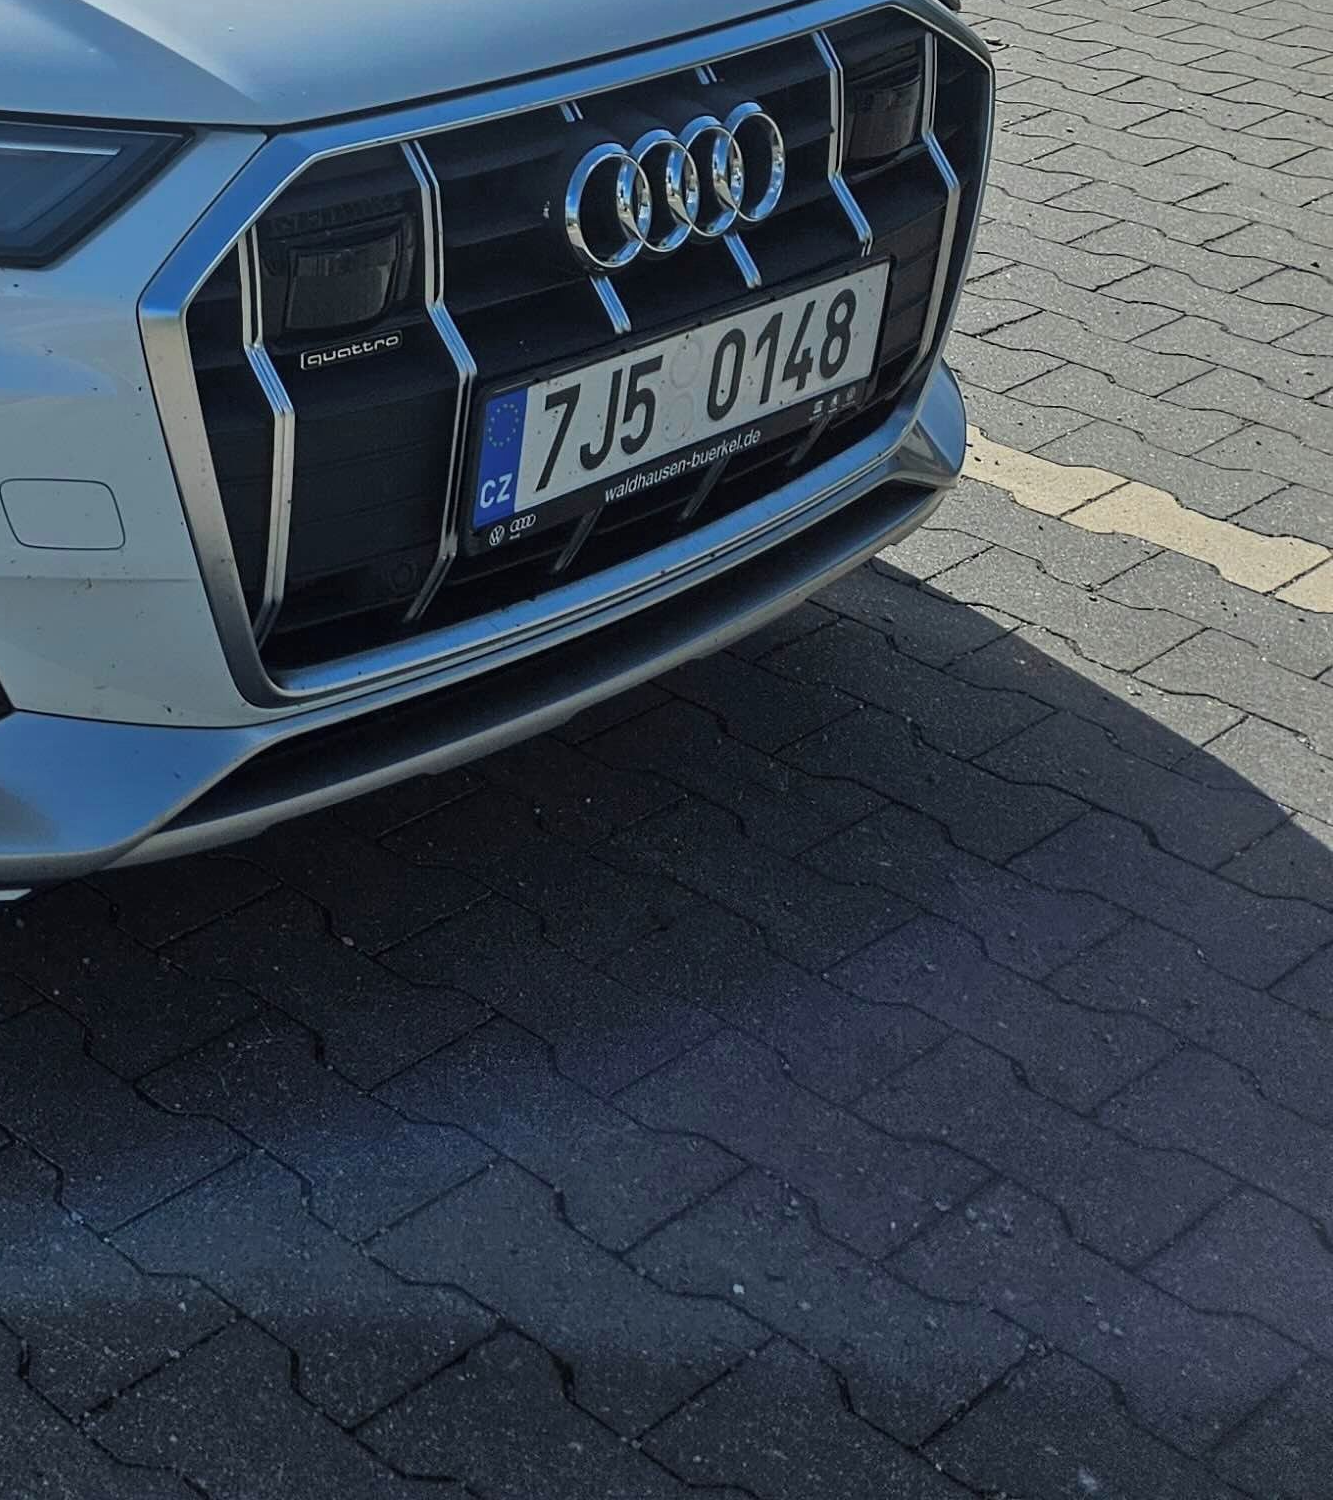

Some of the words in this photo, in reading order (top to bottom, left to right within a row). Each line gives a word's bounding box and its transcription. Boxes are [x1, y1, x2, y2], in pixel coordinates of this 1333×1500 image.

[307, 335, 400, 365] quattro
[536, 355, 663, 493] 7J5
[707, 288, 857, 421] 0148
[479, 472, 513, 509] CZ
[604, 429, 762, 502] waldhausen-buerkel.de
